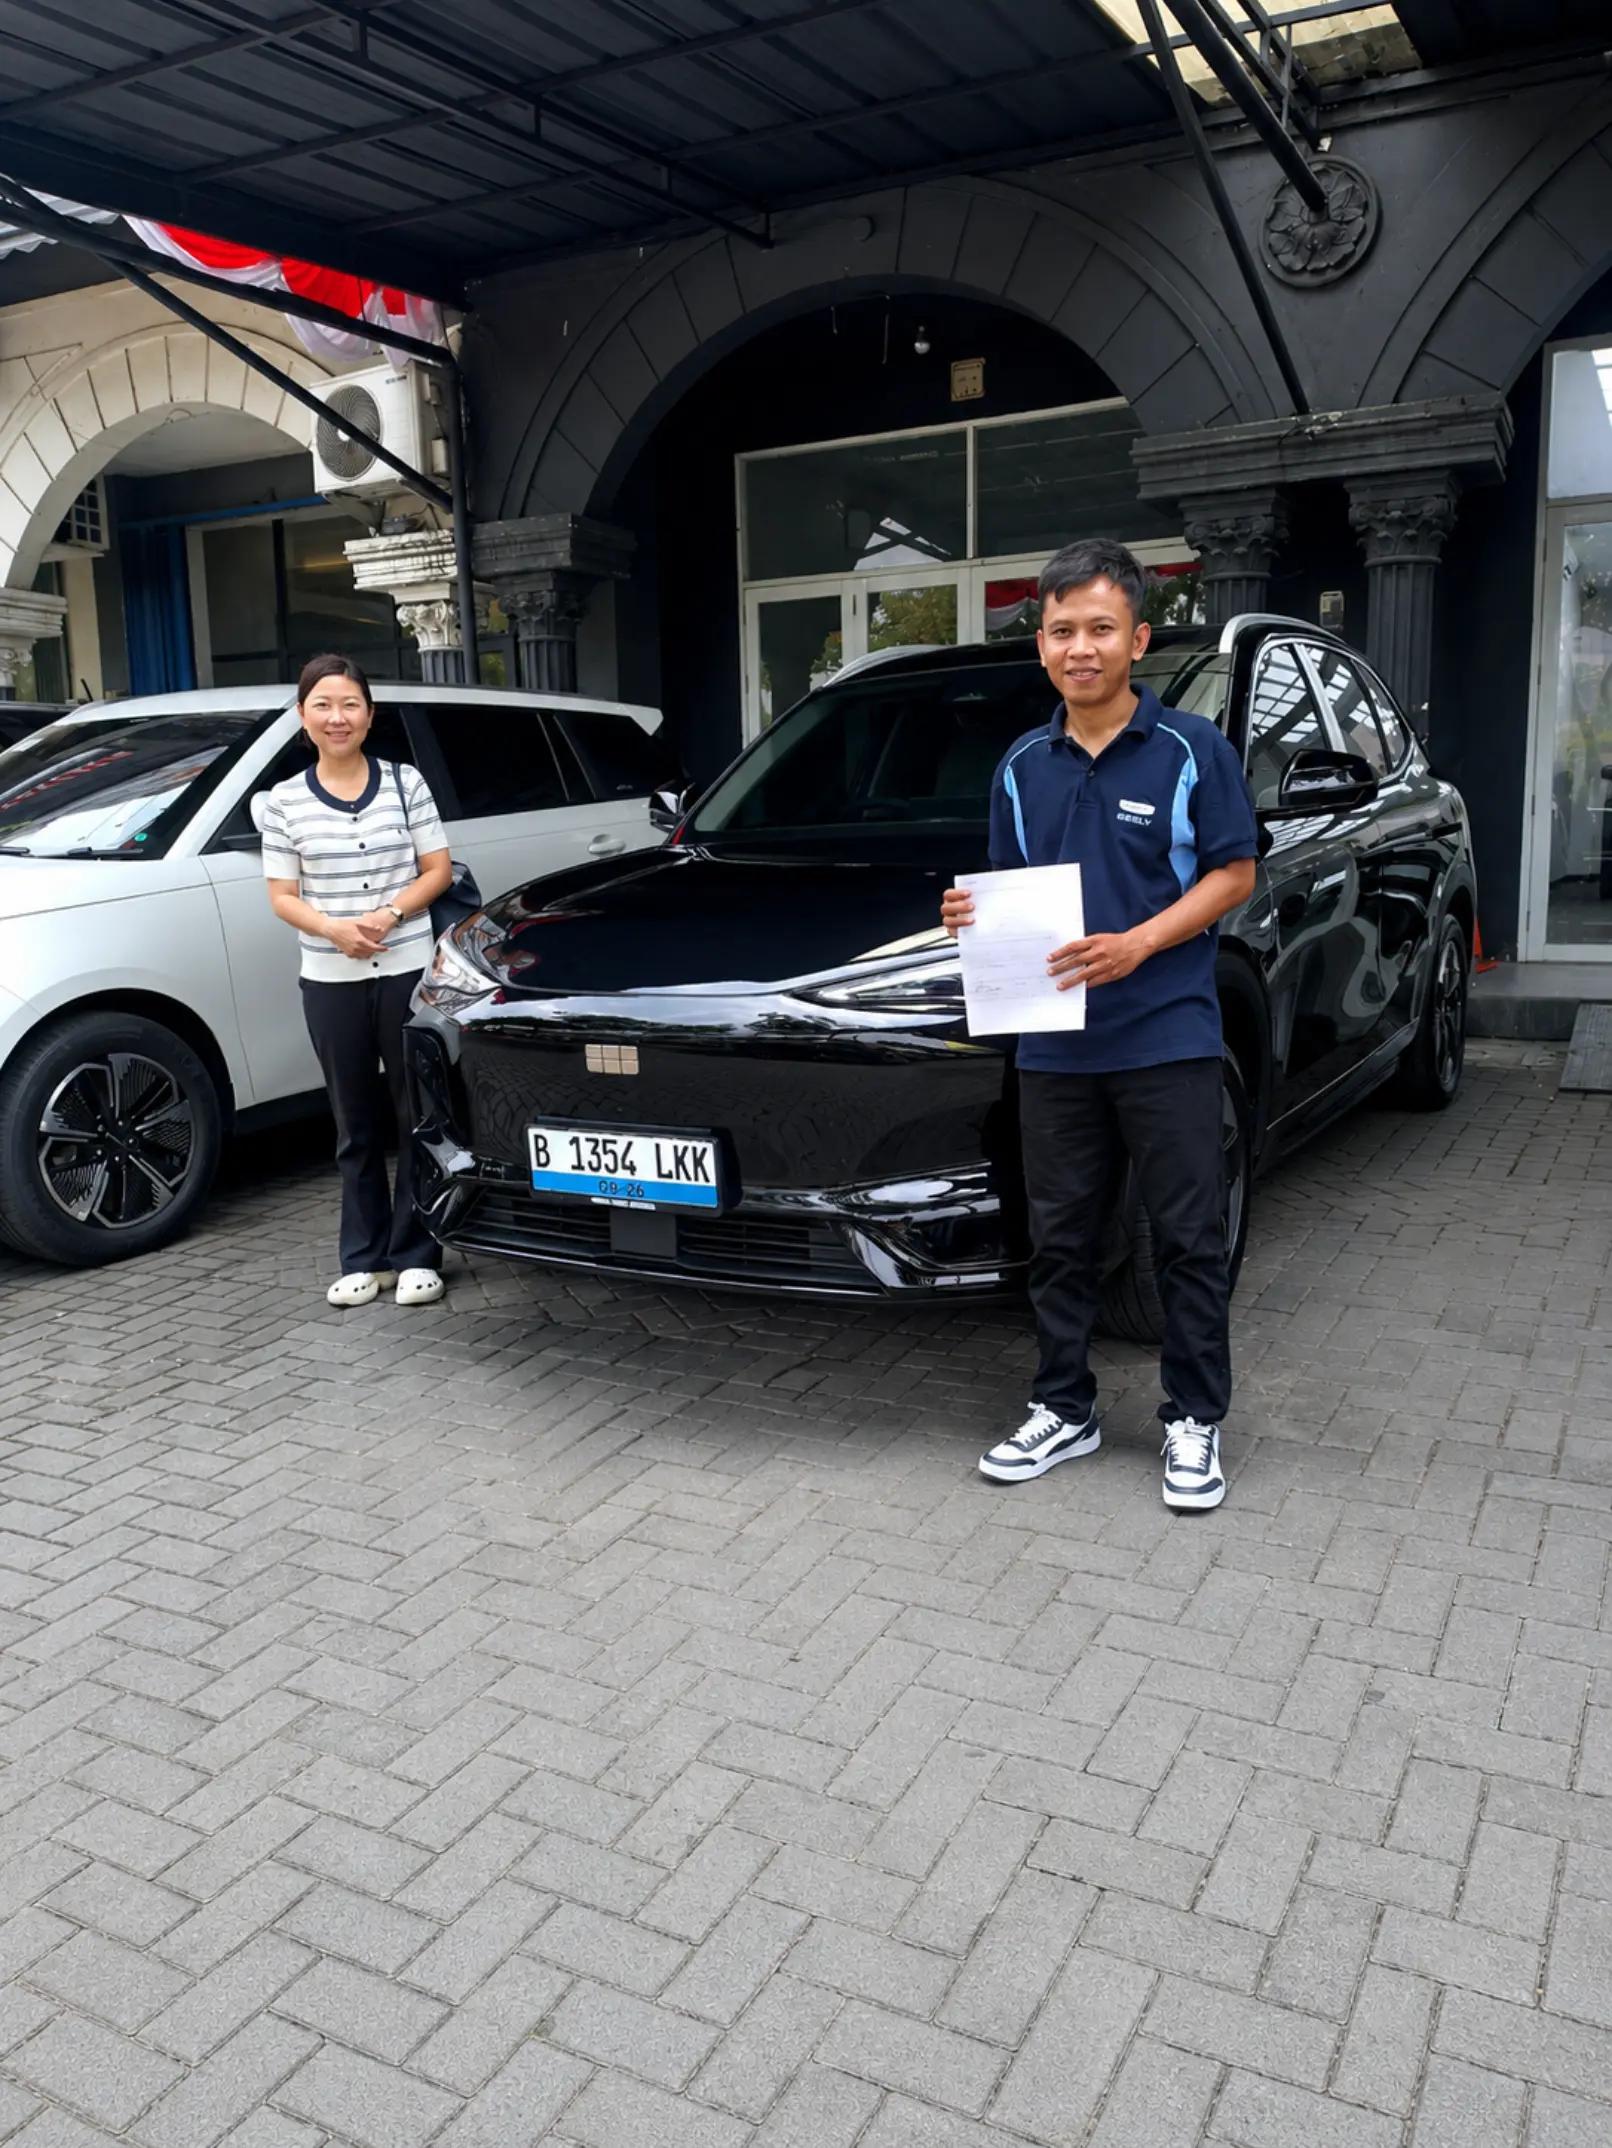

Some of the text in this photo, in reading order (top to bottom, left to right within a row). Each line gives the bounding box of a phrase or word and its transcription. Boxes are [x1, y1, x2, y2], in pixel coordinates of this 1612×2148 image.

[1117, 813, 1152, 826] GEELY
[534, 1134, 711, 1182] B 1354 LKK
